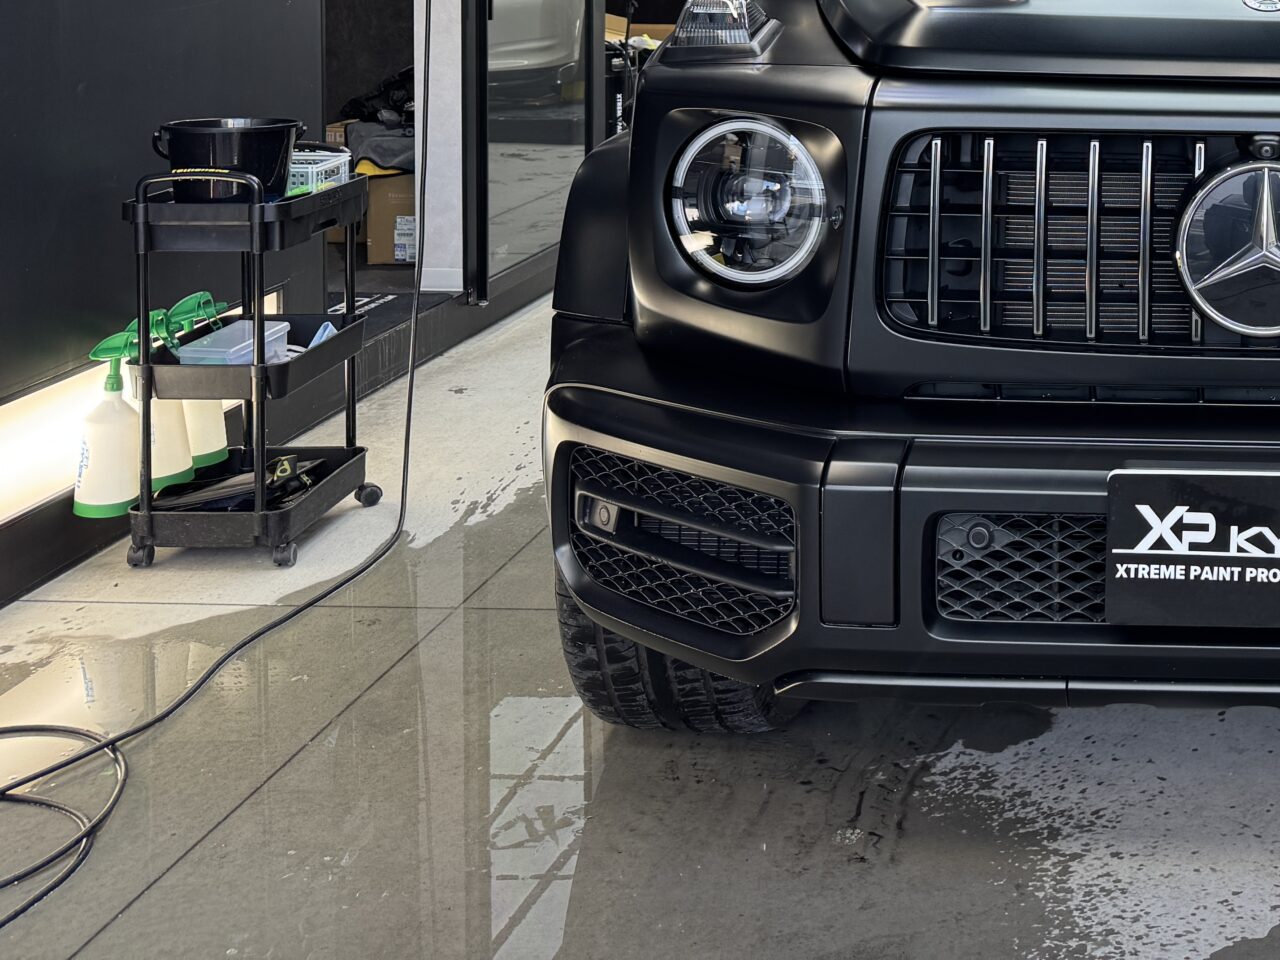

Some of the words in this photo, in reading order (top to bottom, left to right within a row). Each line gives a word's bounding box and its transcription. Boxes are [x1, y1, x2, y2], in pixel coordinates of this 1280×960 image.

[1134, 503, 1217, 553] XP
[1114, 563, 1186, 580] XTREME
[1189, 565, 1242, 582] PAINT
